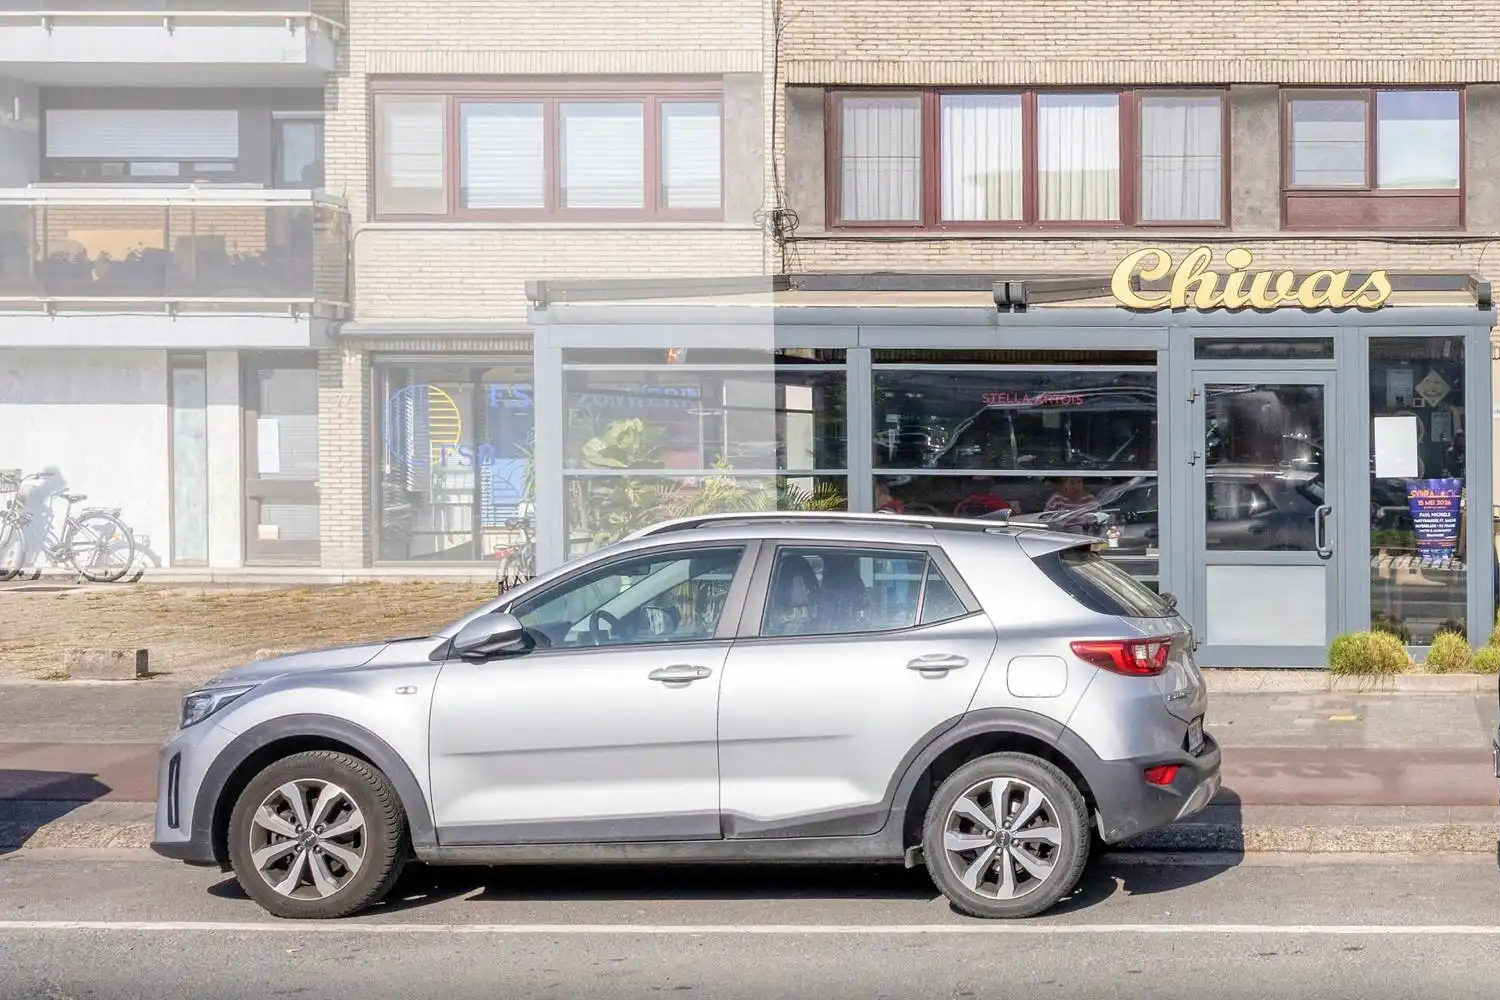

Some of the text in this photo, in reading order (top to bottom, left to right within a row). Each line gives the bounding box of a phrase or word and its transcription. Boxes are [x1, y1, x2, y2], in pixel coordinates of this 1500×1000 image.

[1111, 246, 1392, 309] Chivas
[489, 383, 533, 408] FS
[982, 391, 1084, 405] STELLA ARTOIS
[440, 444, 495, 466] FSB
